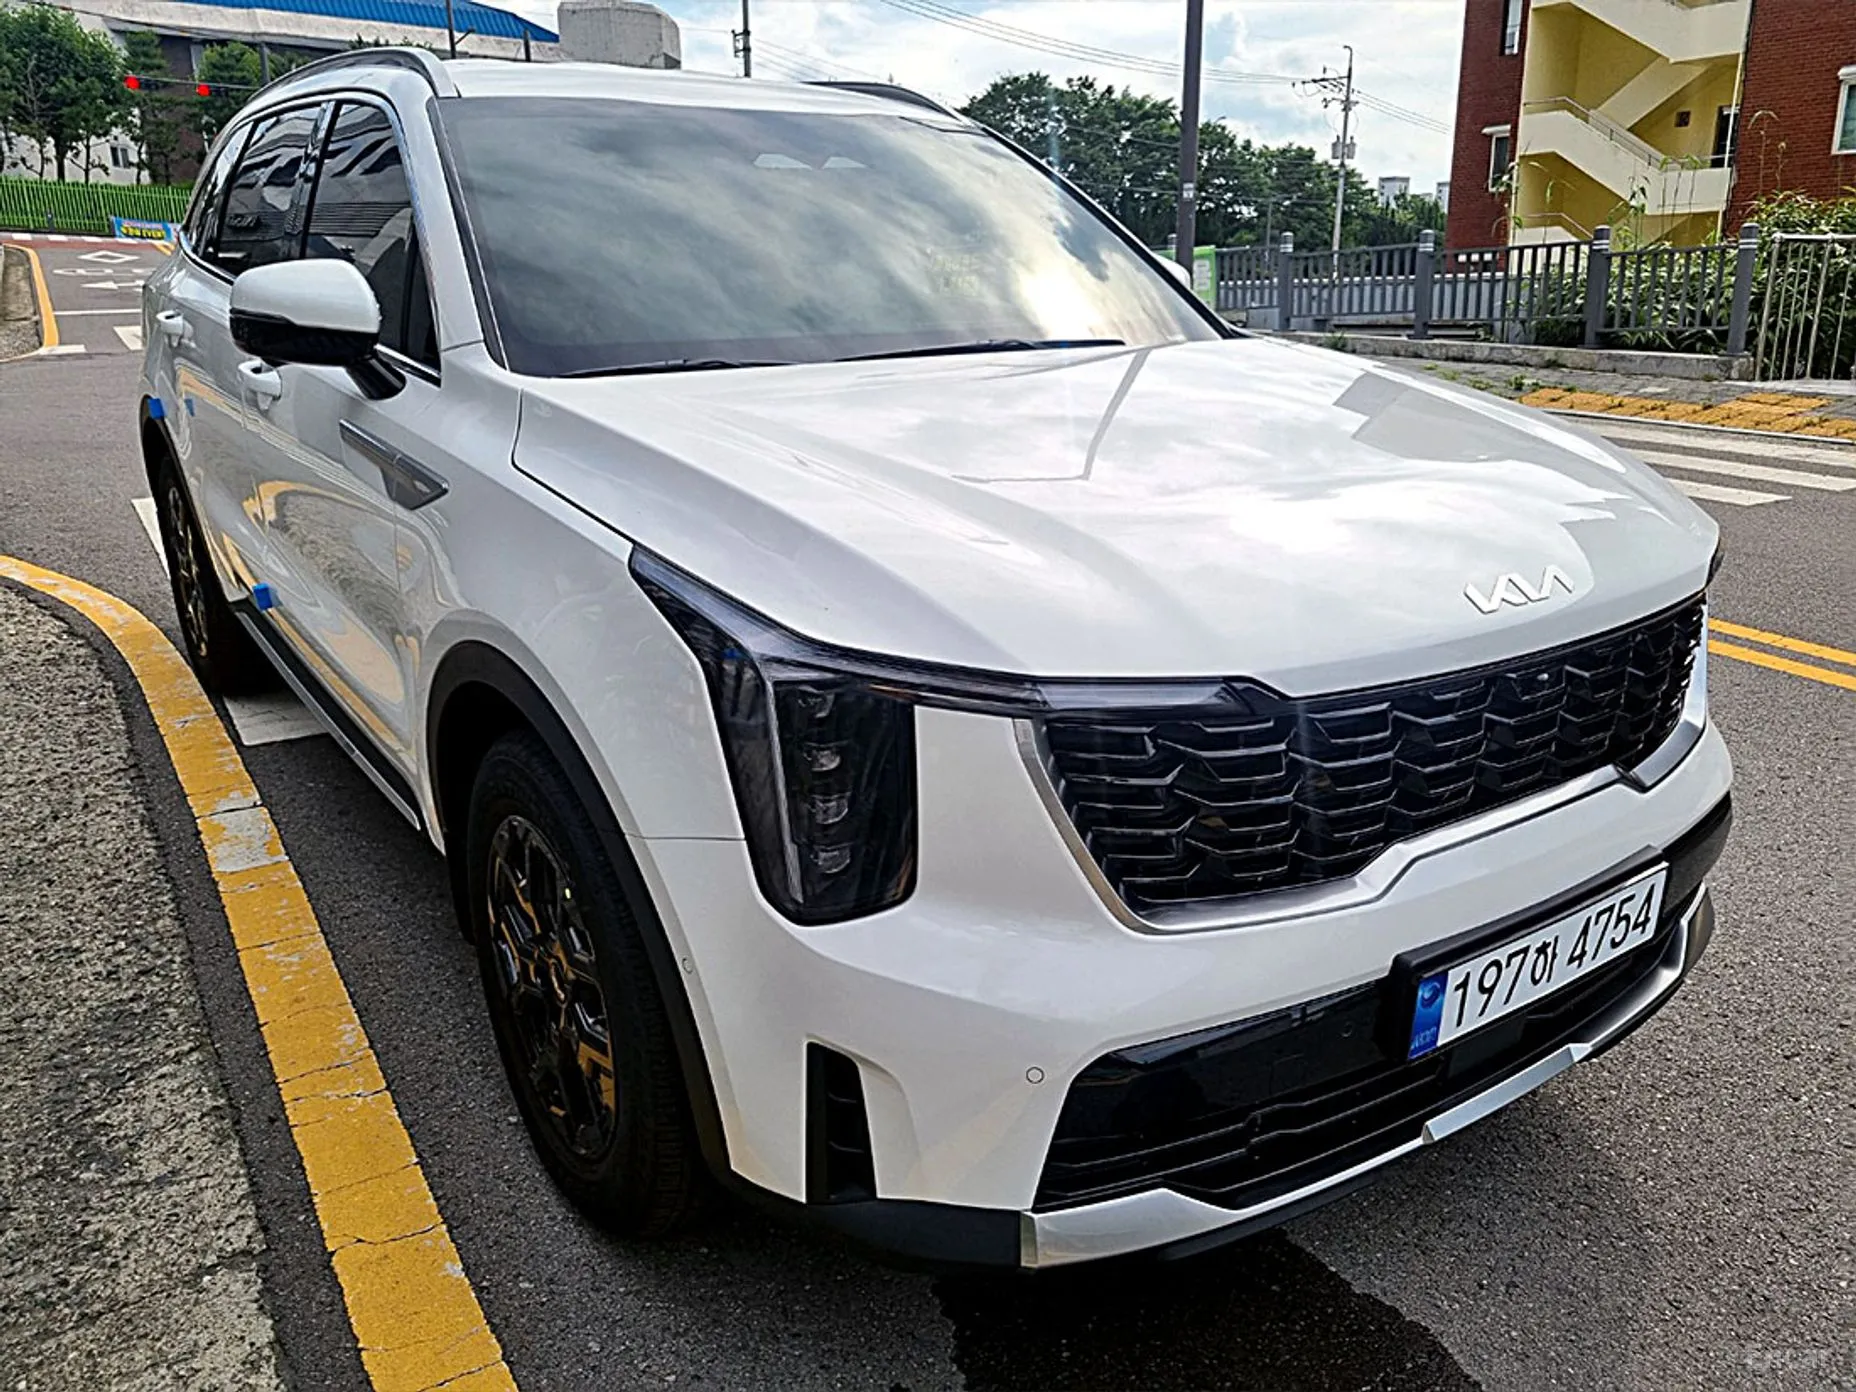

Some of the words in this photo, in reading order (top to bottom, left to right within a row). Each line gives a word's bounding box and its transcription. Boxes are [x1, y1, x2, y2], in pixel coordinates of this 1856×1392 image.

[1463, 564, 1574, 614] KIA
[1453, 935, 1559, 1027] 197하
[1566, 883, 1656, 969] 4754
